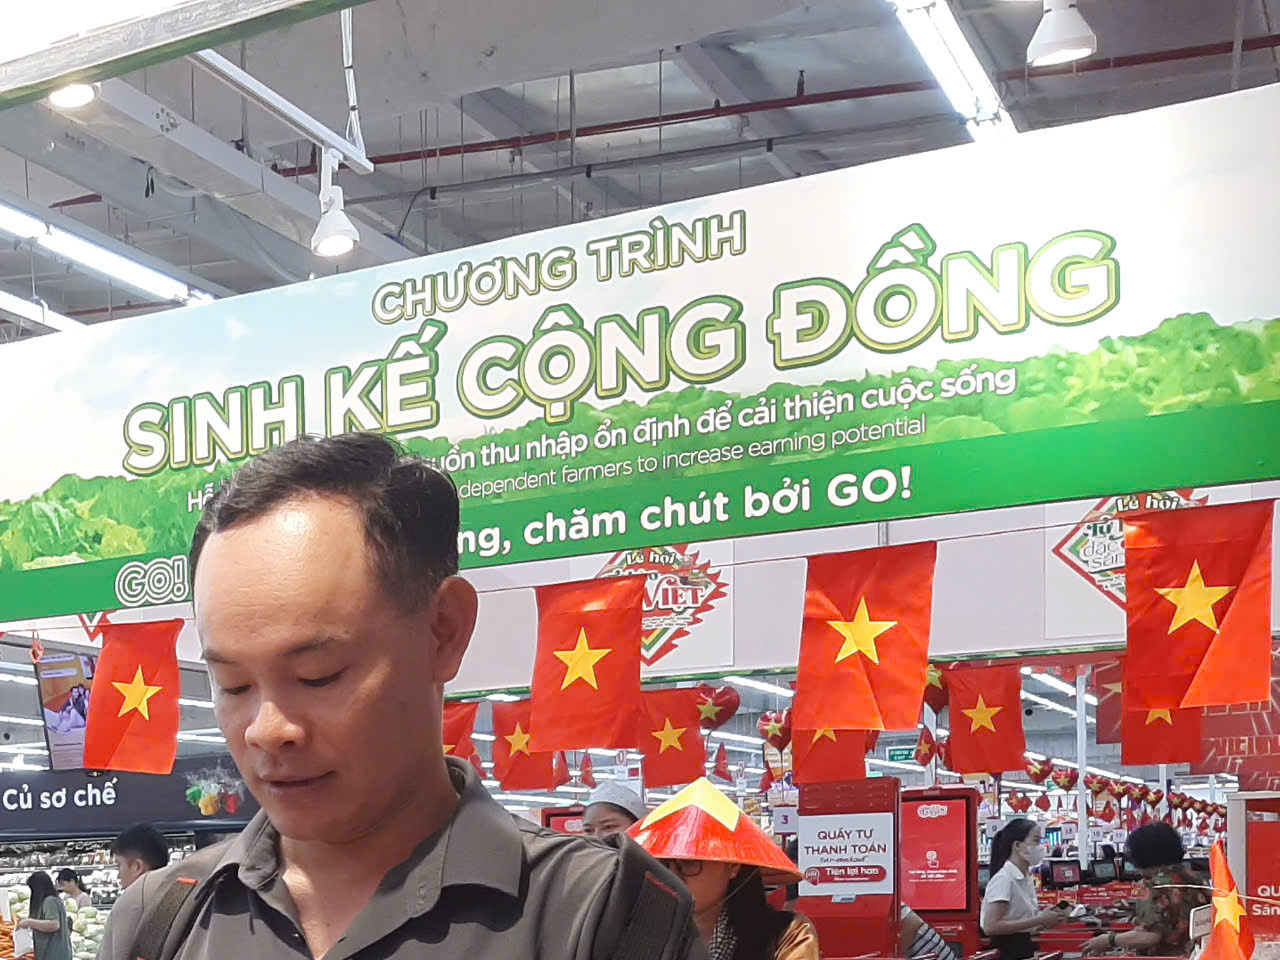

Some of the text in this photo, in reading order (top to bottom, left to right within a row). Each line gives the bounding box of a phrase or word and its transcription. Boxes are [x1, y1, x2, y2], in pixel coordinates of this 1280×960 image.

[372, 210, 746, 324] CHƯƠNG TRÌNH
[122, 223, 1120, 477] SINH KẾ CỘNG ĐỒNG
[459, 413, 927, 498] dependent farmers to increase earning potential
[480, 442, 520, 466] thu
[526, 430, 588, 464] nhập
[596, 418, 628, 450] ổn
[633, 413, 690, 447] định
[696, 400, 732, 433] để
[738, 396, 776, 427] cải
[783, 388, 855, 421] thiện
[861, 376, 934, 411] cuộc
[940, 364, 1017, 399] sống
[115, 464, 913, 607] GO! ng, chăm chút bởi GO!
[3, 784, 33, 810] Củ
[40, 789, 67, 809] sơ
[73, 777, 117, 806] chế
[781, 815, 789, 825] 3
[856, 828, 873, 840] TỰ
[804, 842, 886, 855] THANH TOÁN
